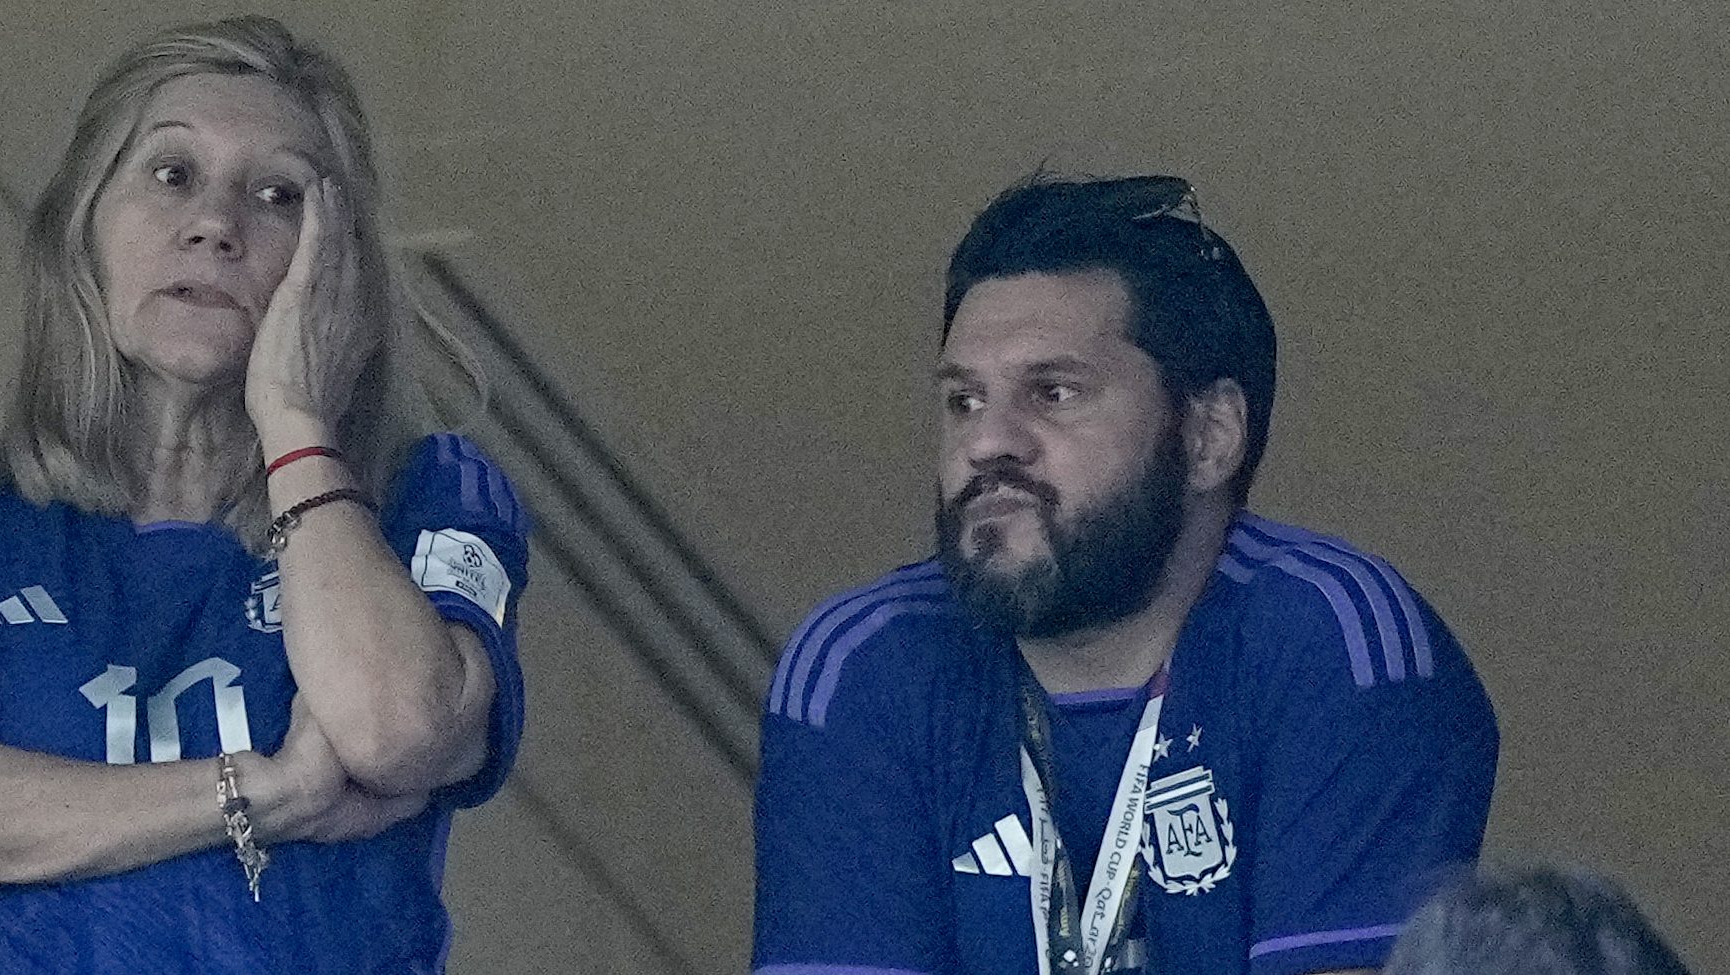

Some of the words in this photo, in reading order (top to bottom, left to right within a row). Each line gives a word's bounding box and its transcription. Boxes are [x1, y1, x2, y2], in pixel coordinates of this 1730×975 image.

[78, 656, 253, 765] 10
[1130, 763, 1151, 794] FIFA
[1115, 797, 1140, 850] WORLD
[1166, 803, 1213, 857] AFA
[1106, 851, 1123, 881] CUP
